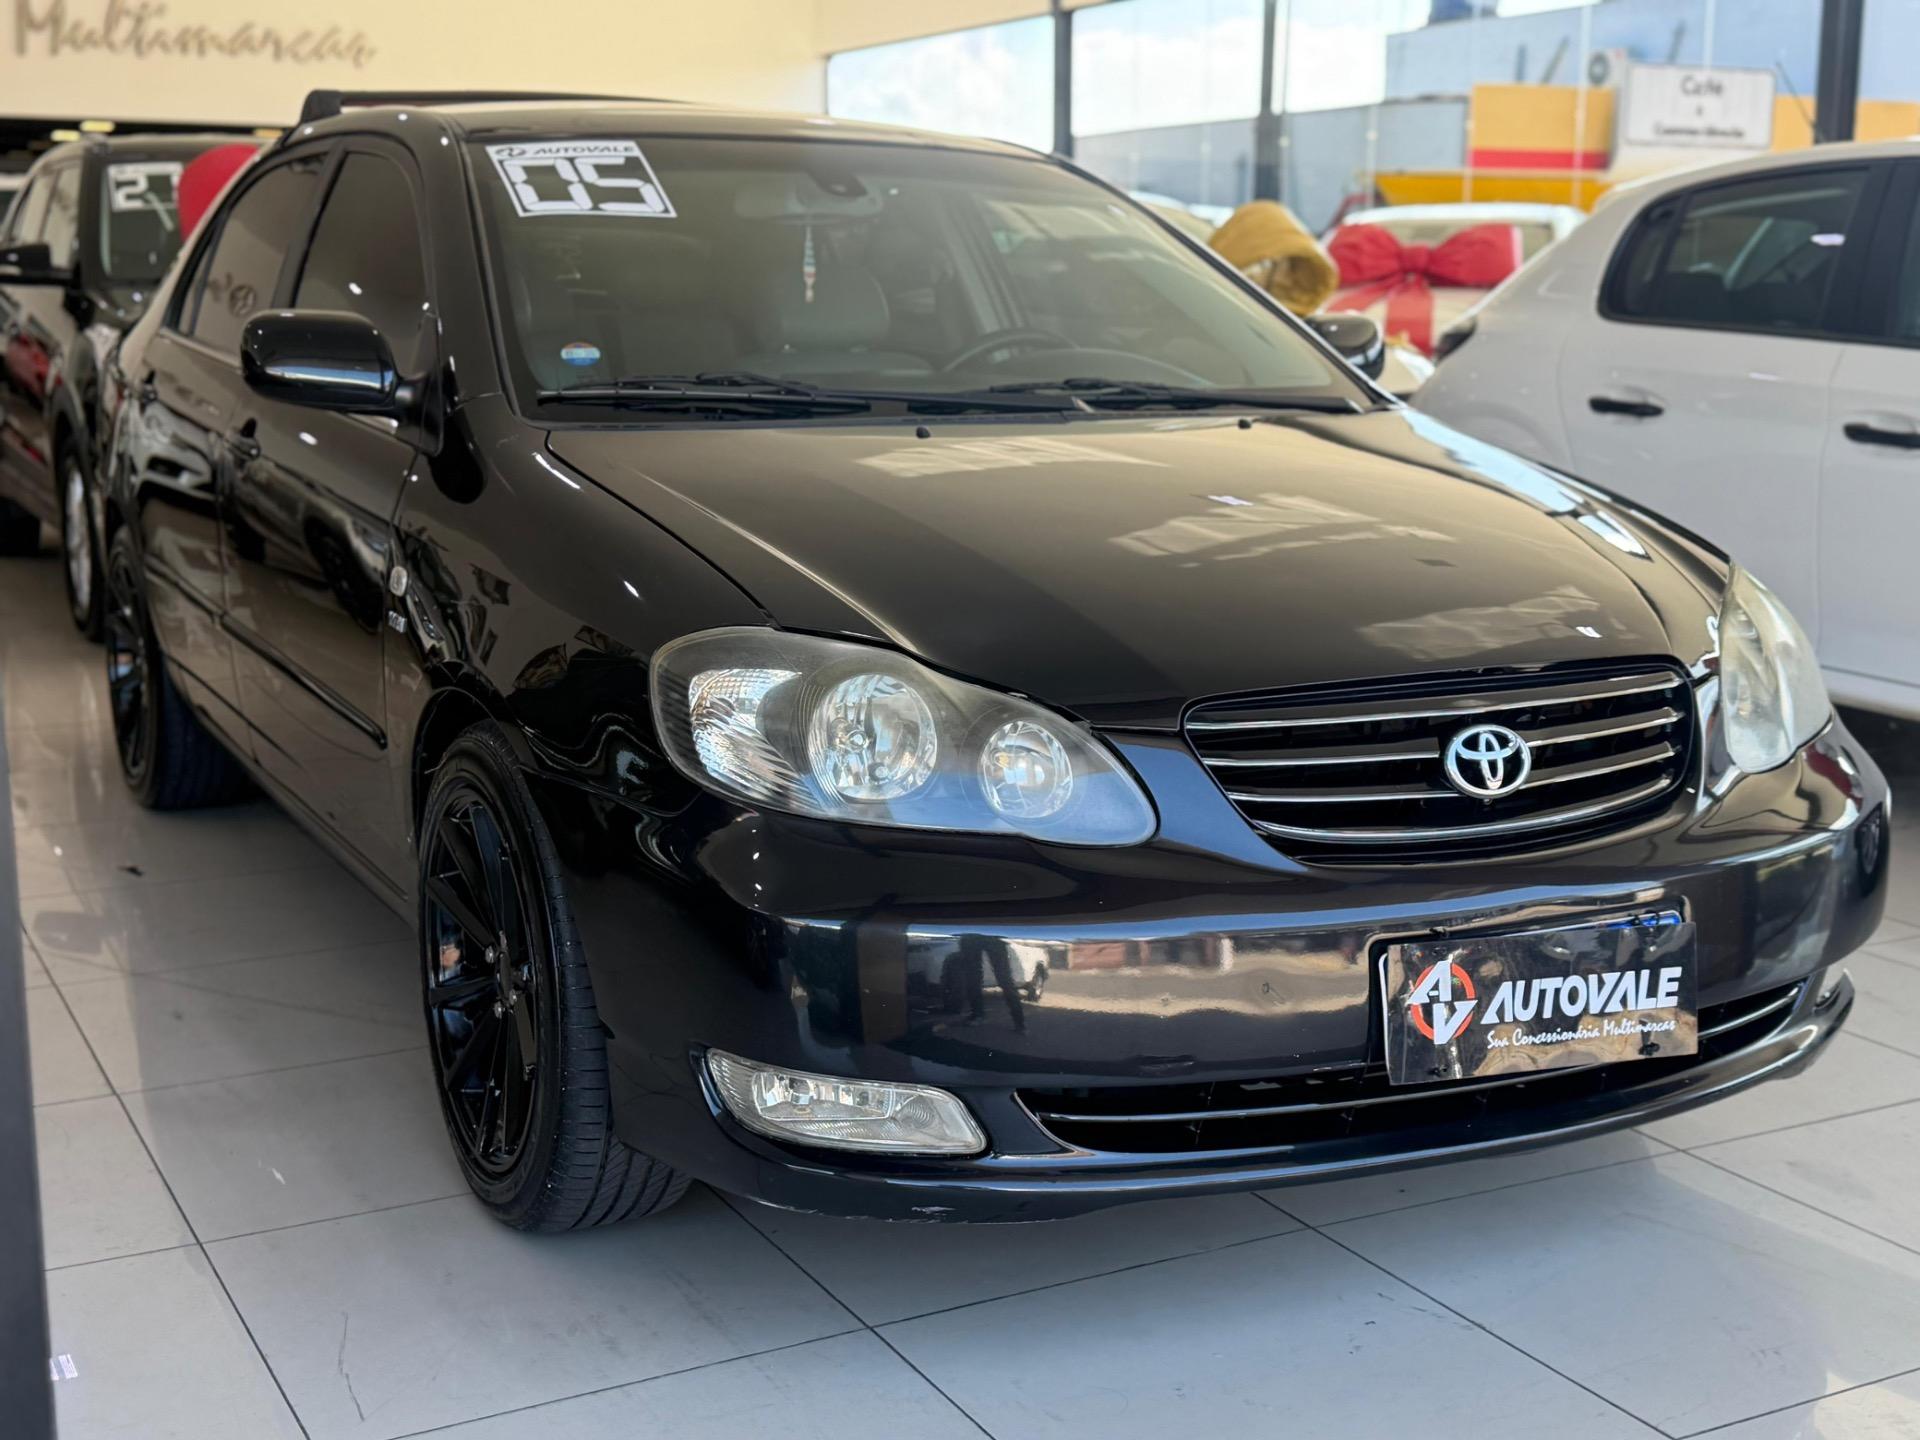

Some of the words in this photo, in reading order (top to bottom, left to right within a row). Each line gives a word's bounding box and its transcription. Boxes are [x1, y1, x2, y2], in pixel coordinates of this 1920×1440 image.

[14, 0, 377, 70] Multimarcas
[534, 145, 636, 155] AUTOVALE
[503, 158, 665, 212] 05
[1480, 967, 1682, 1024] AUTOVALE
[1487, 1030, 1510, 1049] Sua
[1603, 1018, 1677, 1037] Multimarcas
